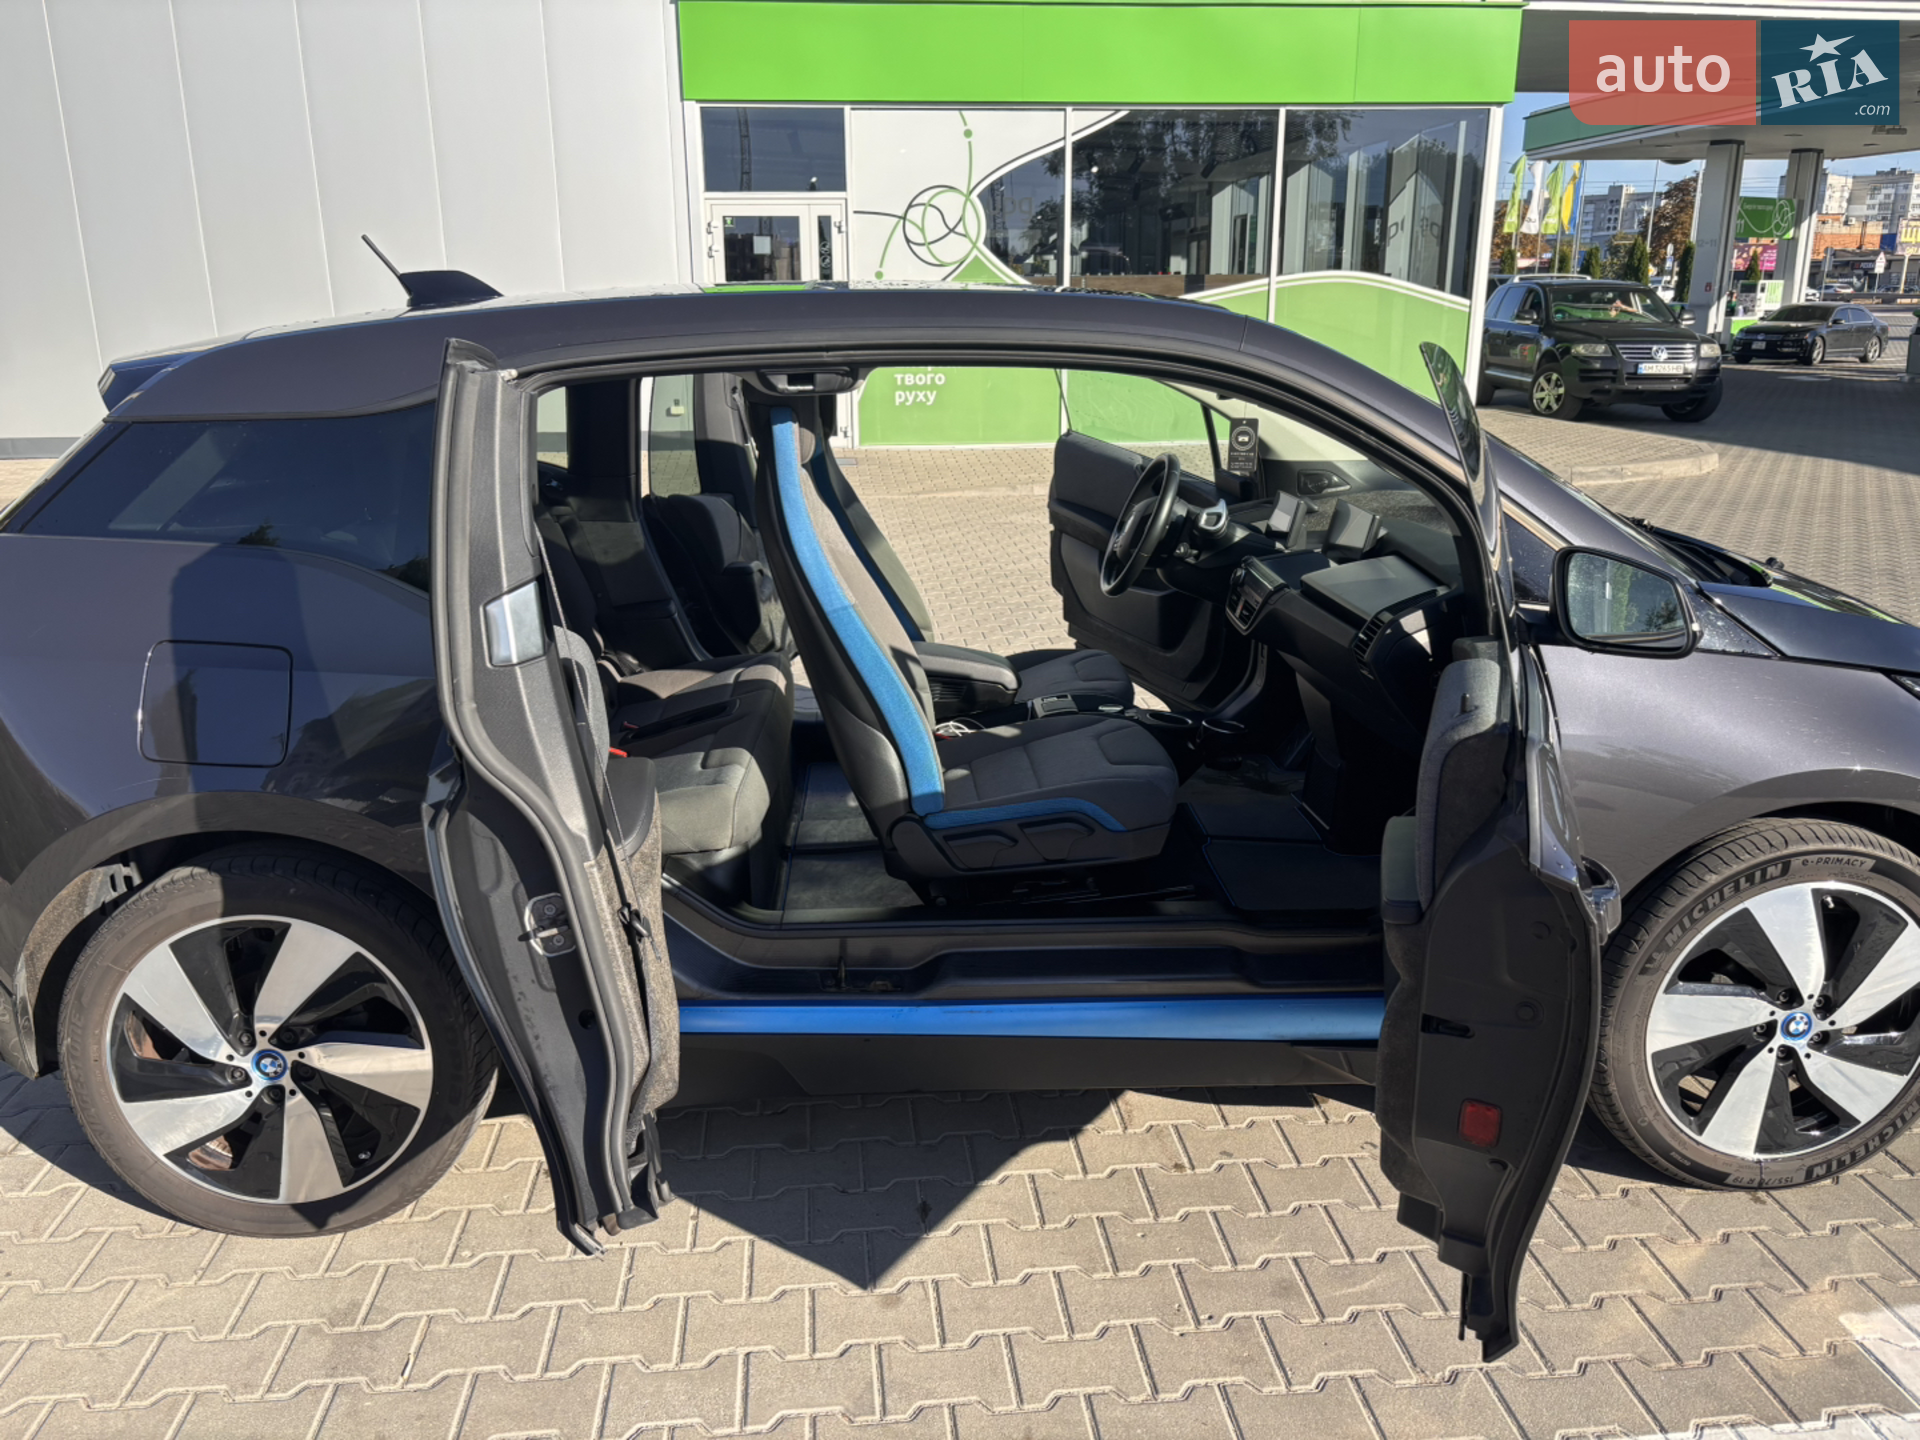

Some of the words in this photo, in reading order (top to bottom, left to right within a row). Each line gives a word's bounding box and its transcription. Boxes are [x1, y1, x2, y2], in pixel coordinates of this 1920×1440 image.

[894, 372, 946, 386] твого
[895, 390, 937, 406] руху
[1801, 856, 1867, 869] e-PRIMACY
[1664, 862, 1783, 948] MICHELIN
[1811, 1101, 1920, 1179] MICHELIN
